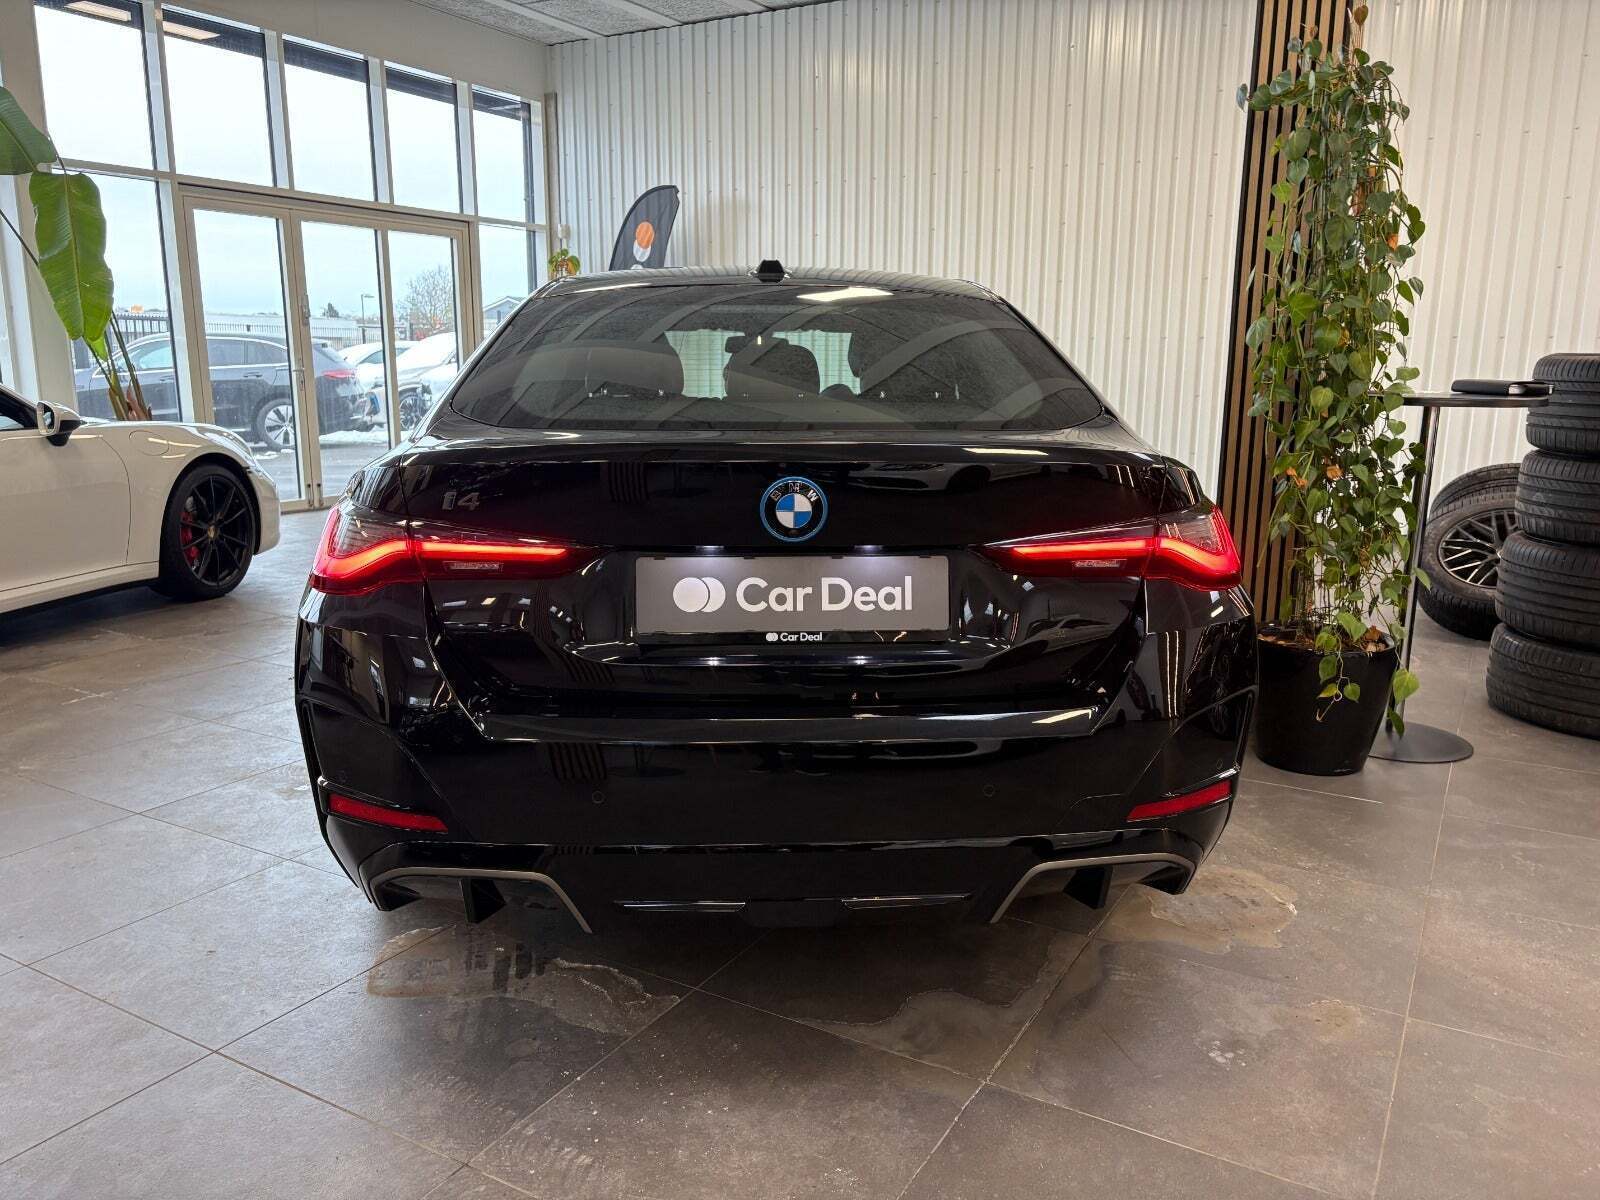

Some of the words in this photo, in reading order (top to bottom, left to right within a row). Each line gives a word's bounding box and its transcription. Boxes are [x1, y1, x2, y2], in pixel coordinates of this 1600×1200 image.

[442, 491, 480, 511] i4
[770, 482, 819, 502] BMW
[736, 576, 812, 612] Car
[821, 575, 913, 612] Deal
[780, 632, 799, 642] Car
[800, 632, 823, 642] Deal
